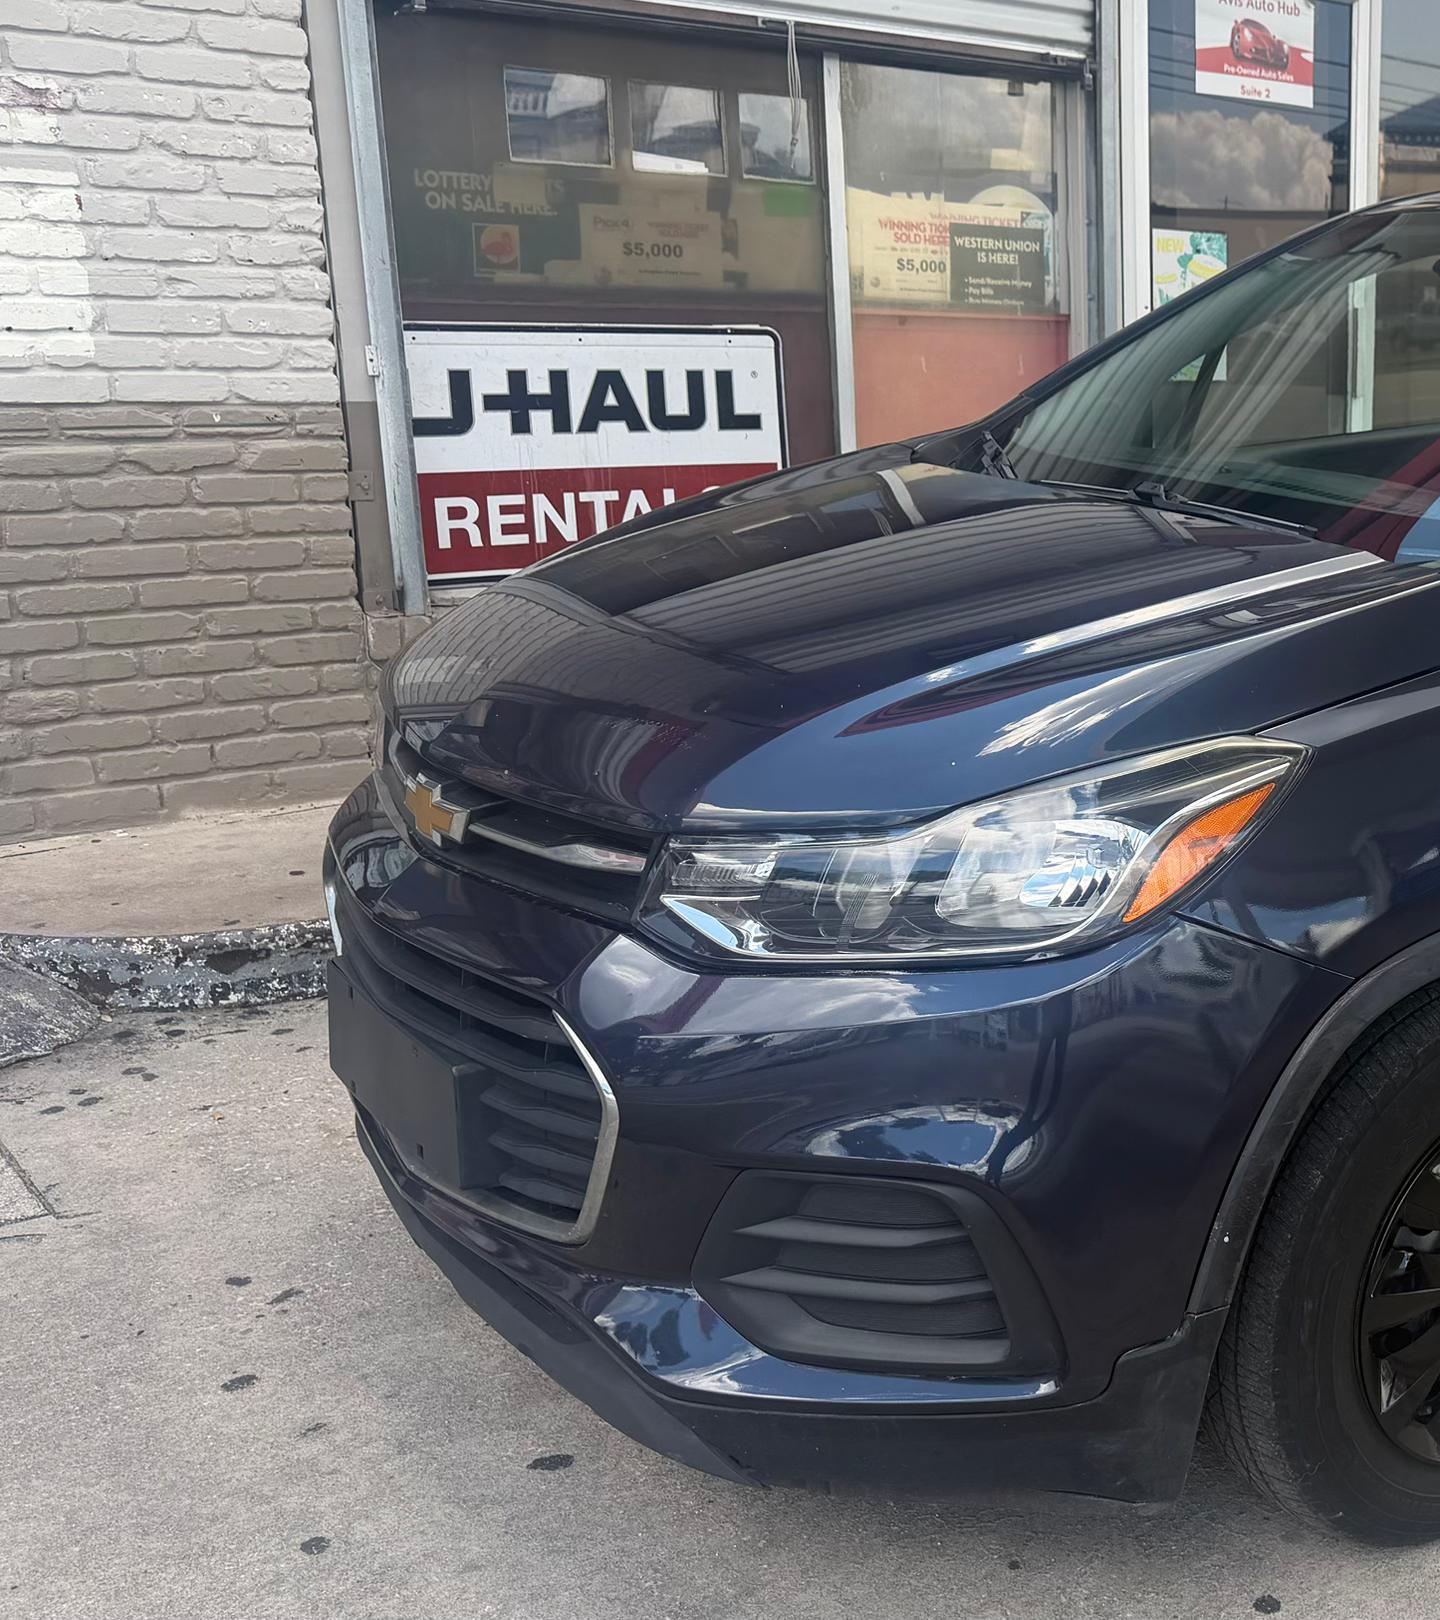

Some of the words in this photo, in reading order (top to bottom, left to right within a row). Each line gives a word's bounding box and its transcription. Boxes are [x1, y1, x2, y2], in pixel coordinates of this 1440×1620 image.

[1246, 0, 1274, 12] Auto
[1278, 2, 1300, 17] Hub
[1223, 62, 1260, 78] Pre-Owned
[1261, 67, 1277, 80] Auto
[1278, 71, 1294, 82] Sales
[1240, 85, 1263, 98] Suite
[1265, 88, 1271, 98] 2
[413, 168, 491, 191] LOTTERY
[425, 191, 456, 210] ON
[462, 193, 505, 213] SALE
[878, 217, 927, 234] WINNING
[893, 232, 922, 244] SOLD
[954, 235, 1003, 250] WESTERN
[1004, 239, 1040, 252] UNION
[1156, 237, 1185, 253] NEW
[623, 241, 684, 259] $5,000
[977, 251, 988, 263] IS
[989, 252, 1019, 265] HERE!
[896, 257, 947, 275] $5,000
[411, 368, 763, 437] U-HAUL
